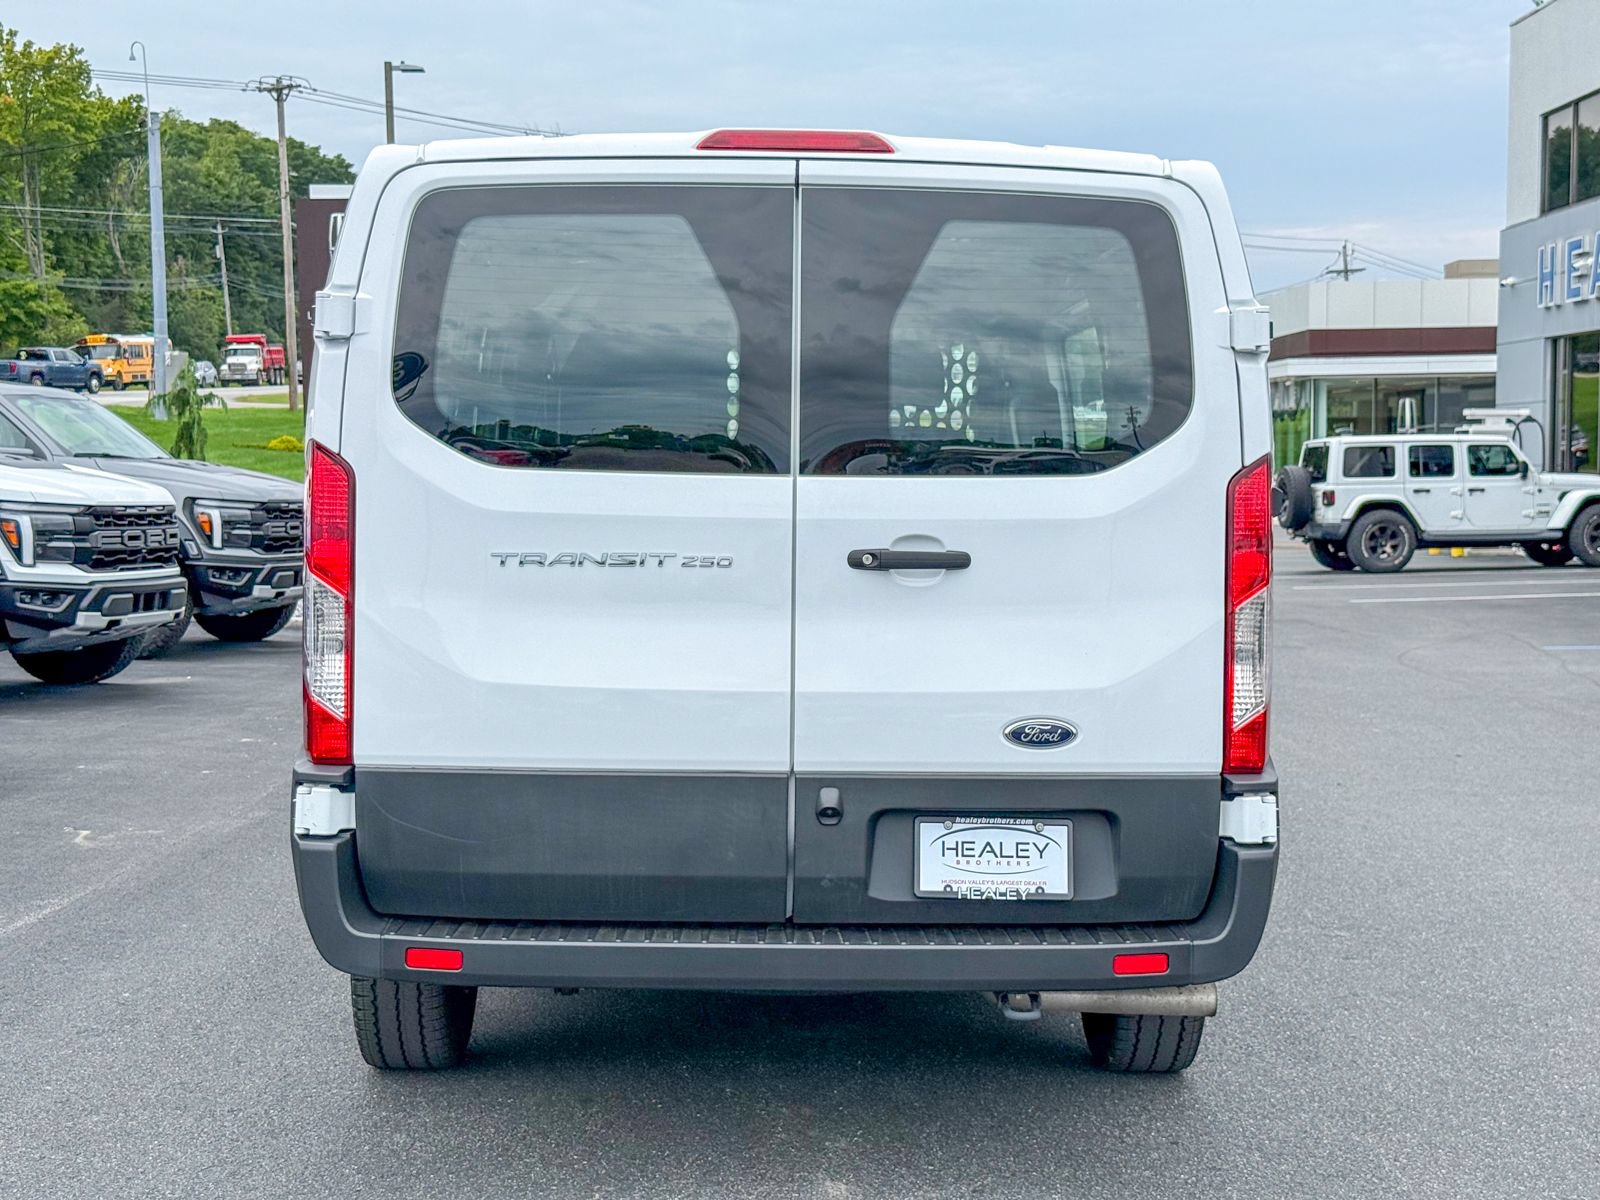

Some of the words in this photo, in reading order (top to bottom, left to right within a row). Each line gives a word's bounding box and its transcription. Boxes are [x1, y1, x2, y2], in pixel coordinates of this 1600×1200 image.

[95, 529, 180, 548] FORD
[490, 552, 677, 568] TRANSIT
[681, 556, 734, 568] 250
[1021, 725, 1062, 742] Ford
[955, 816, 1033, 825] healeybrothers.com
[942, 840, 1050, 859] HEALEY
[957, 886, 1030, 900] HEALEY
